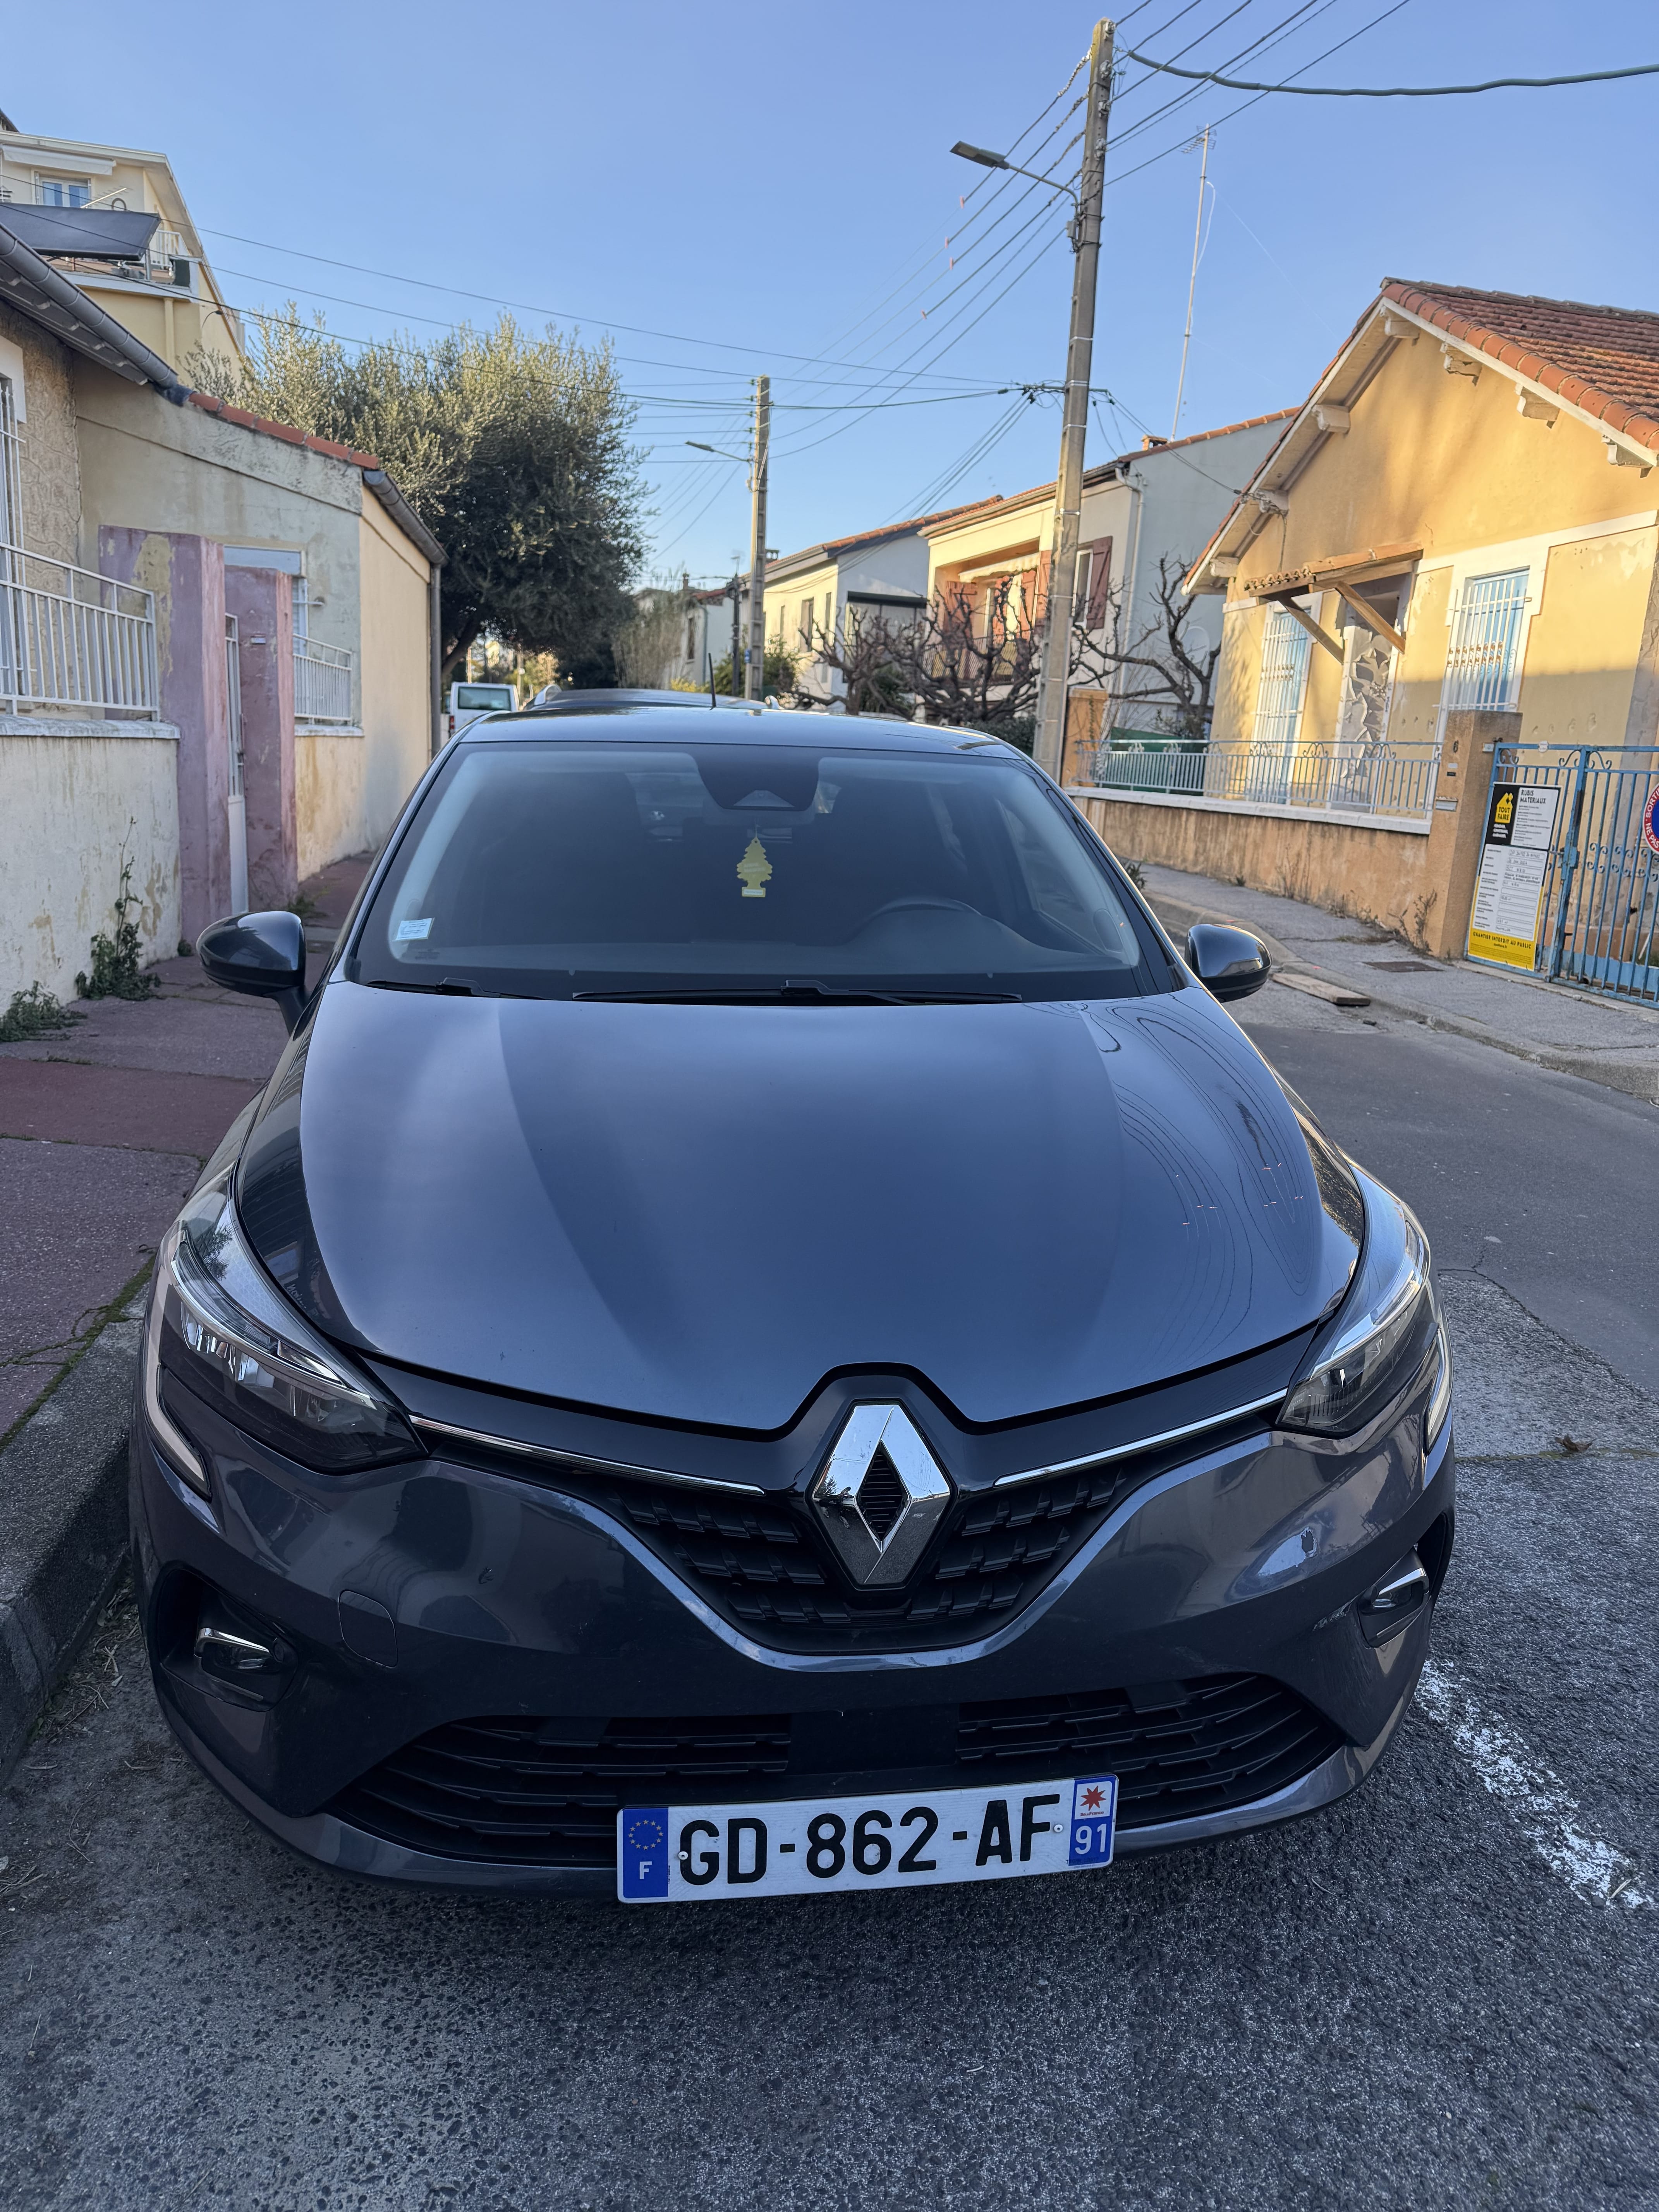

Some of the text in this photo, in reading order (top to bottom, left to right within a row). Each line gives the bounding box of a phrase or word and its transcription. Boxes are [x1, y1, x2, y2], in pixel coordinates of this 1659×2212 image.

[1453, 740, 1459, 753] 6
[1646, 787, 1659, 817] SORTI
[1645, 823, 1659, 848] NE PAS
[1473, 932, 1491, 940] CHANTIER
[1492, 936, 1509, 944] INTERDIT
[680, 1794, 1060, 1885] GD-862-AF
[1075, 1823, 1107, 1855] 91
[639, 1861, 652, 1879] F
